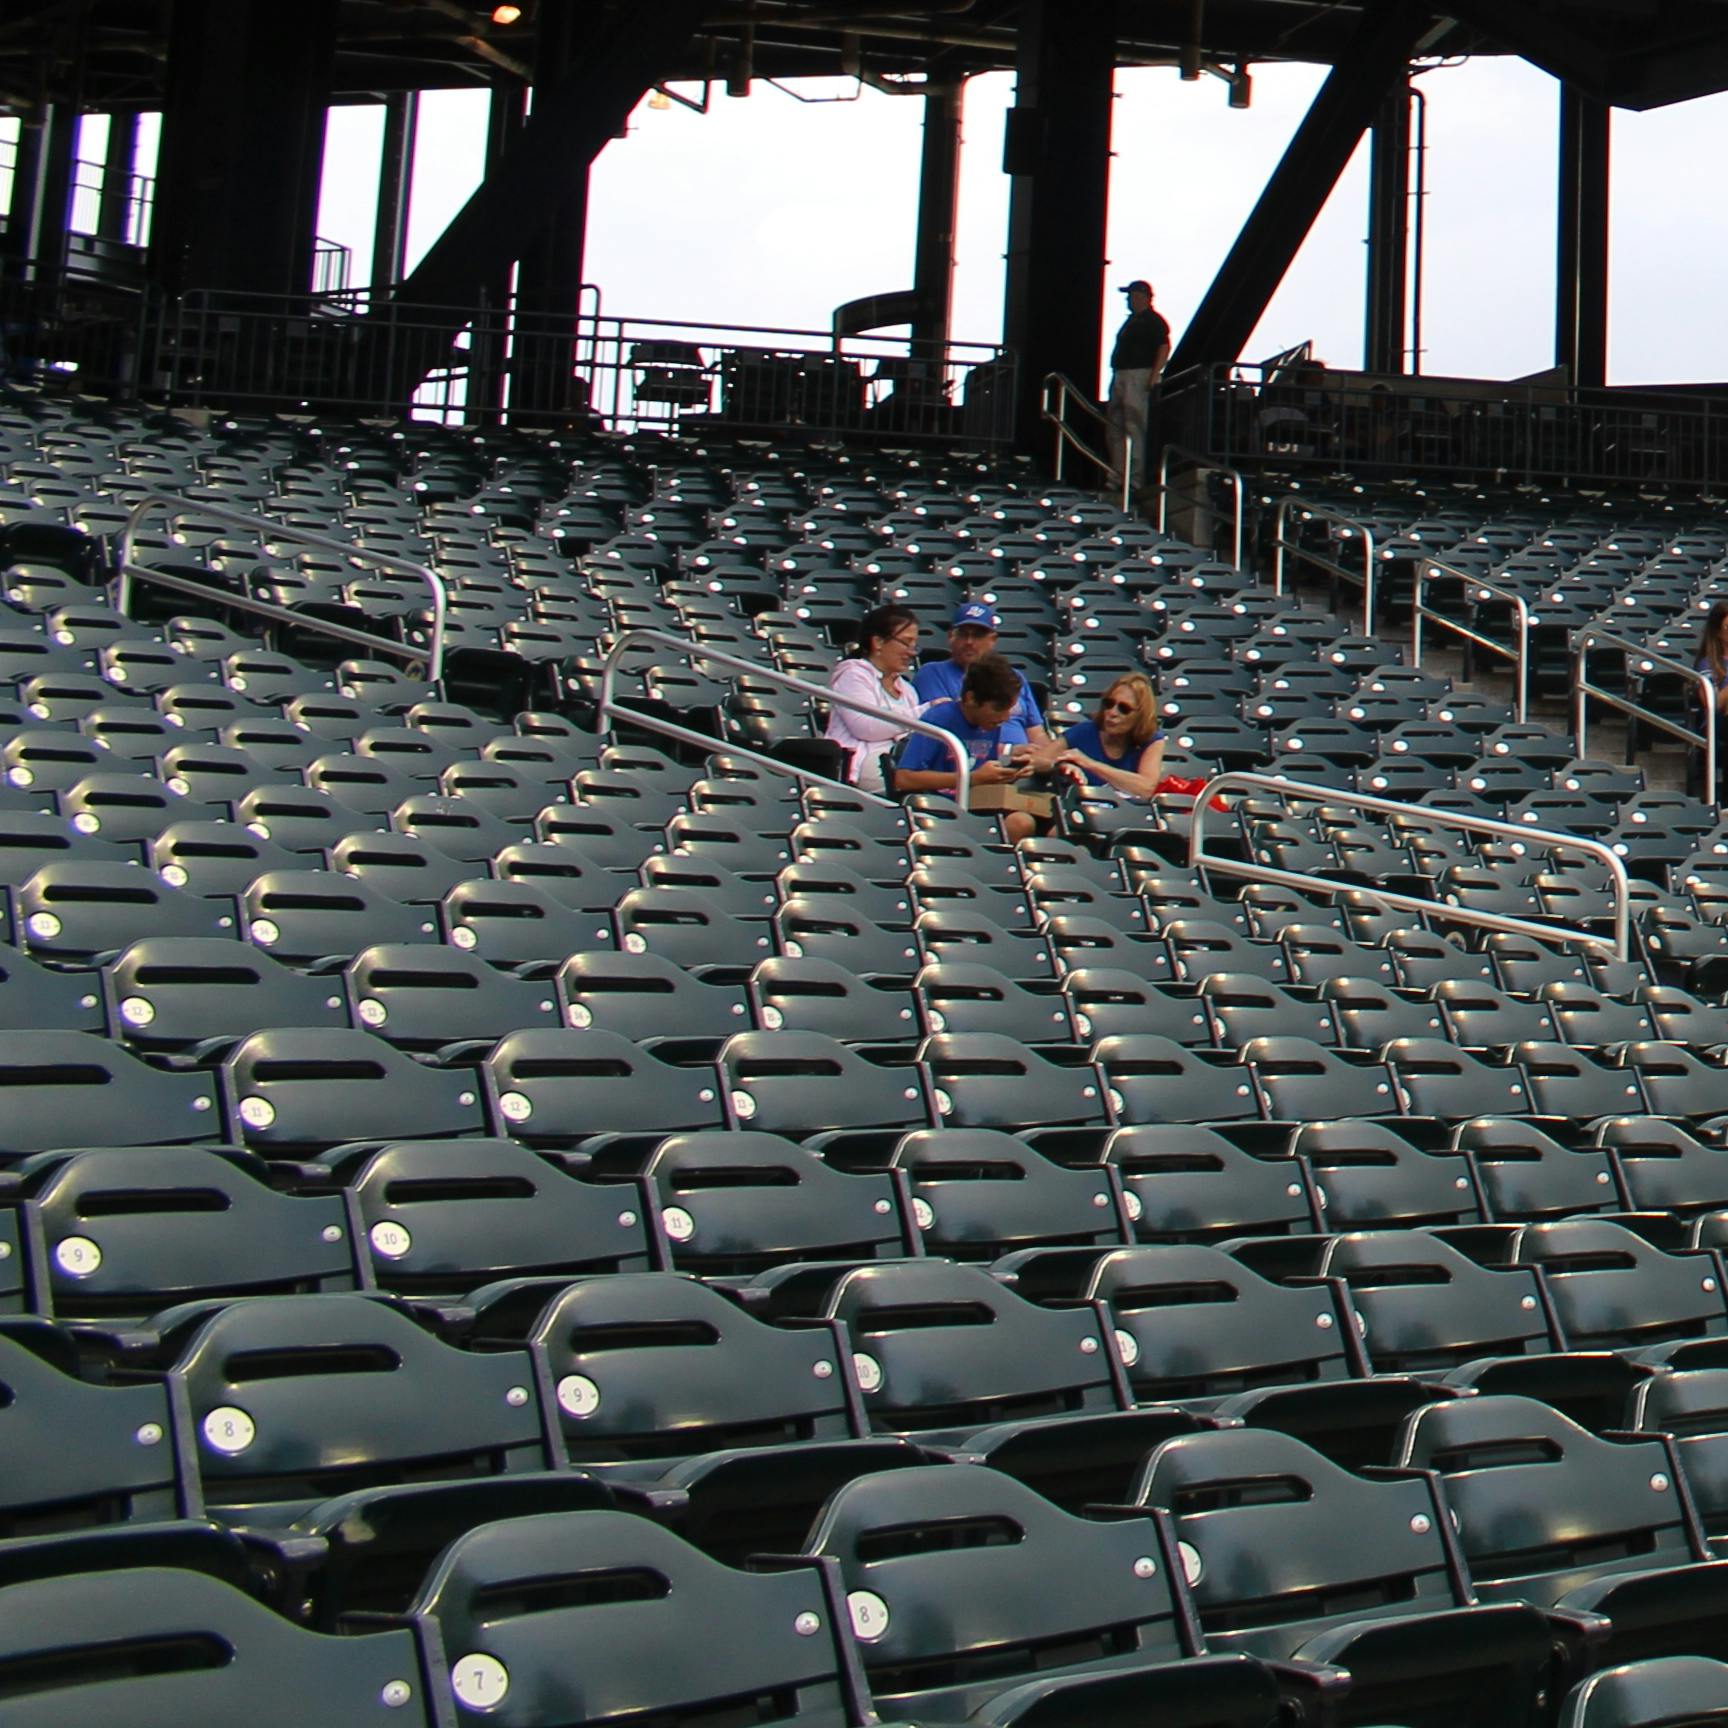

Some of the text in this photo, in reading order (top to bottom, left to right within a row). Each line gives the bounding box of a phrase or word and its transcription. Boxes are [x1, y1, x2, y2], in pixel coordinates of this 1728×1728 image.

[573, 1387, 583, 1403] 9
[224, 1420, 234, 1437] 8
[859, 1606, 870, 1624] 8
[473, 1671, 484, 1690] 7
